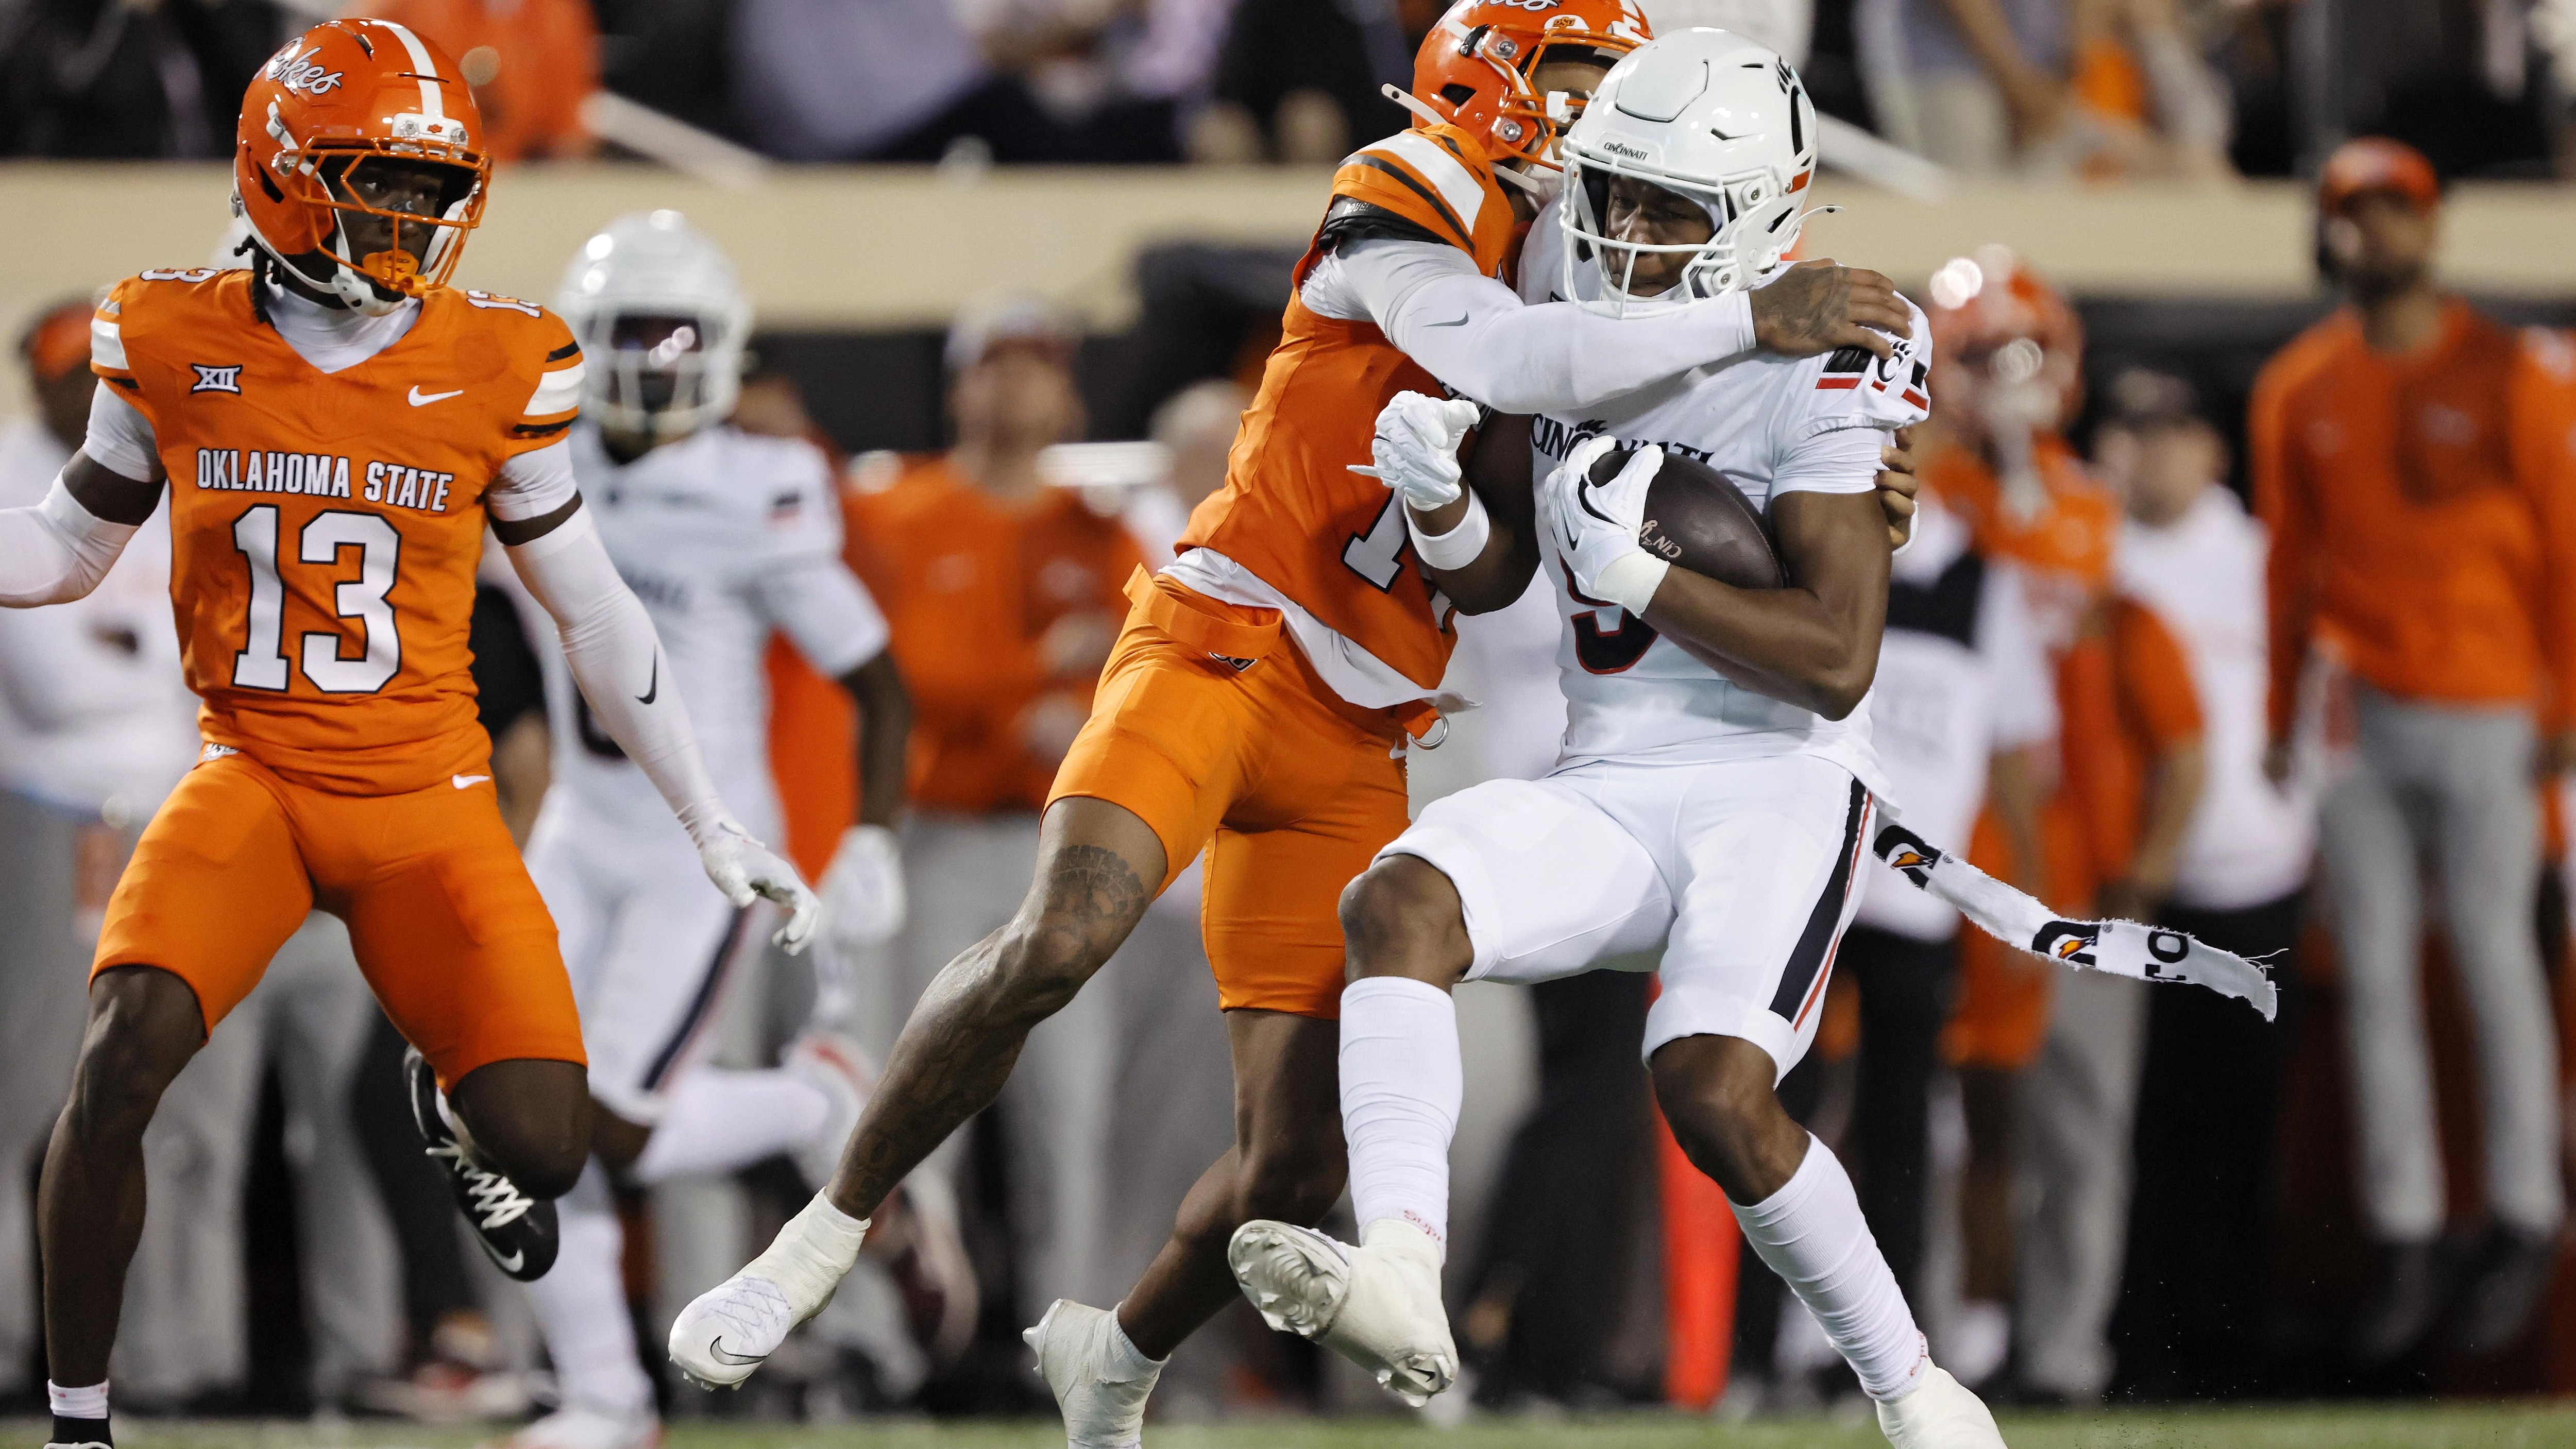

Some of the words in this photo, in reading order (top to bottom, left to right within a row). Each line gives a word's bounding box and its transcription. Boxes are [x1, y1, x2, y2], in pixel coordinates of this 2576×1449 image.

[1603, 141, 1649, 161] CINCINNATI
[191, 363, 242, 395] XII
[197, 449, 350, 498] OKLAHOMA
[364, 461, 453, 512] STATE
[231, 503, 402, 693] 13
